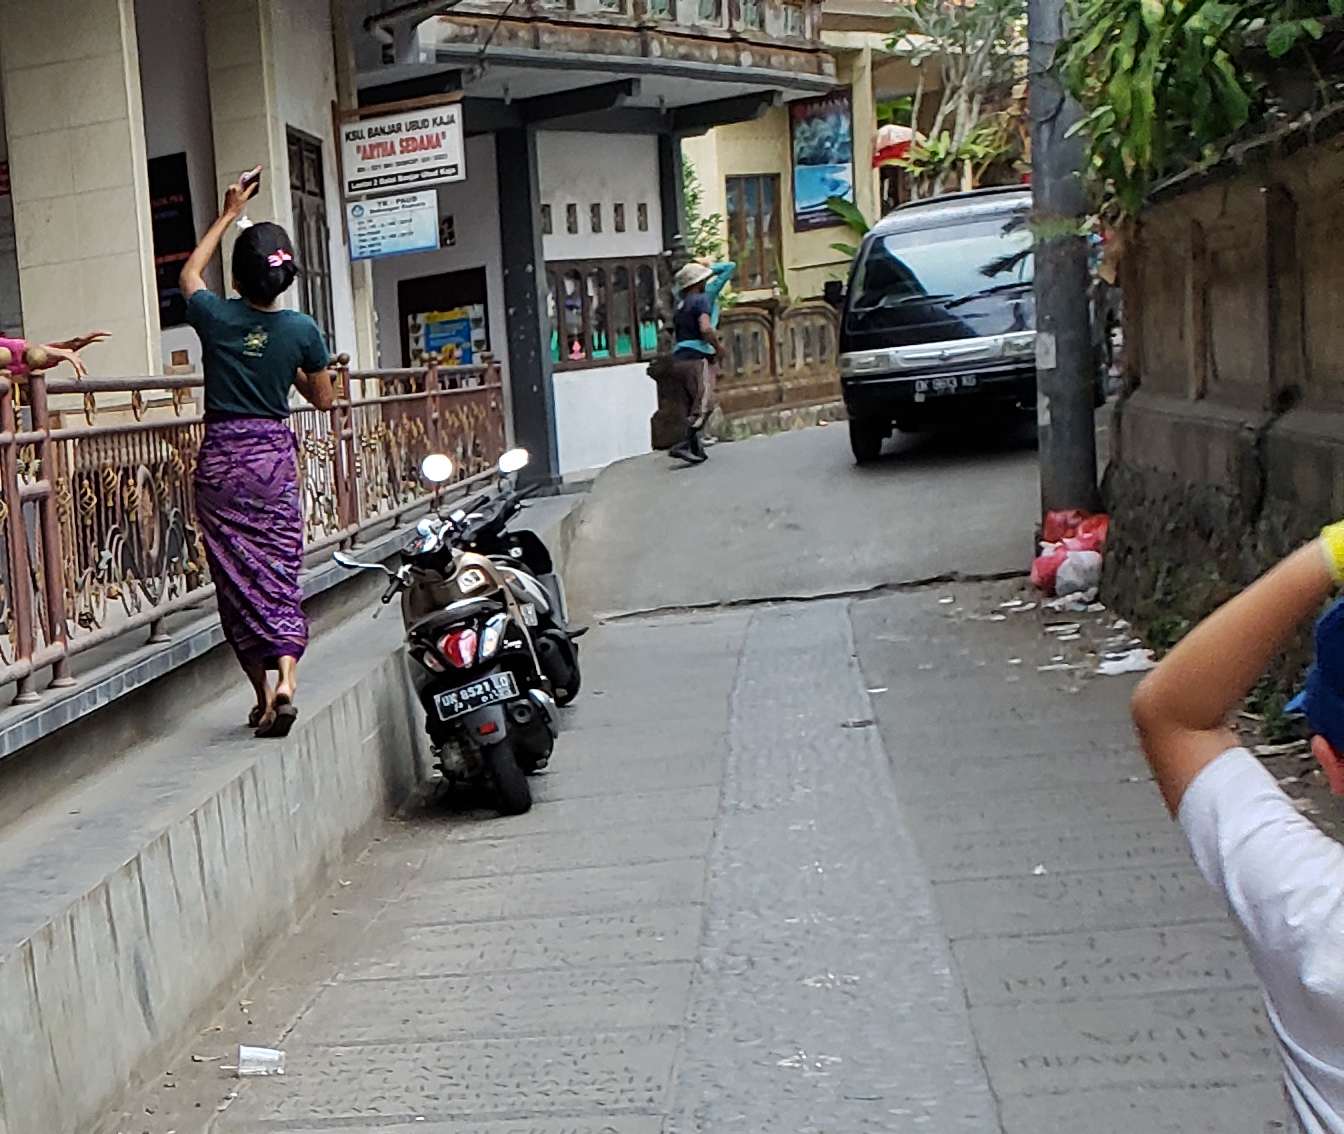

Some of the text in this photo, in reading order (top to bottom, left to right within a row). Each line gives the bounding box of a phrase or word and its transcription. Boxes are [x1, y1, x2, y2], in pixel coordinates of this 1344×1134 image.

[368, 122, 402, 138] BANJAR
[405, 118, 429, 132] UBUD
[432, 113, 456, 128] KAJA
[441, 692, 459, 707] DK
